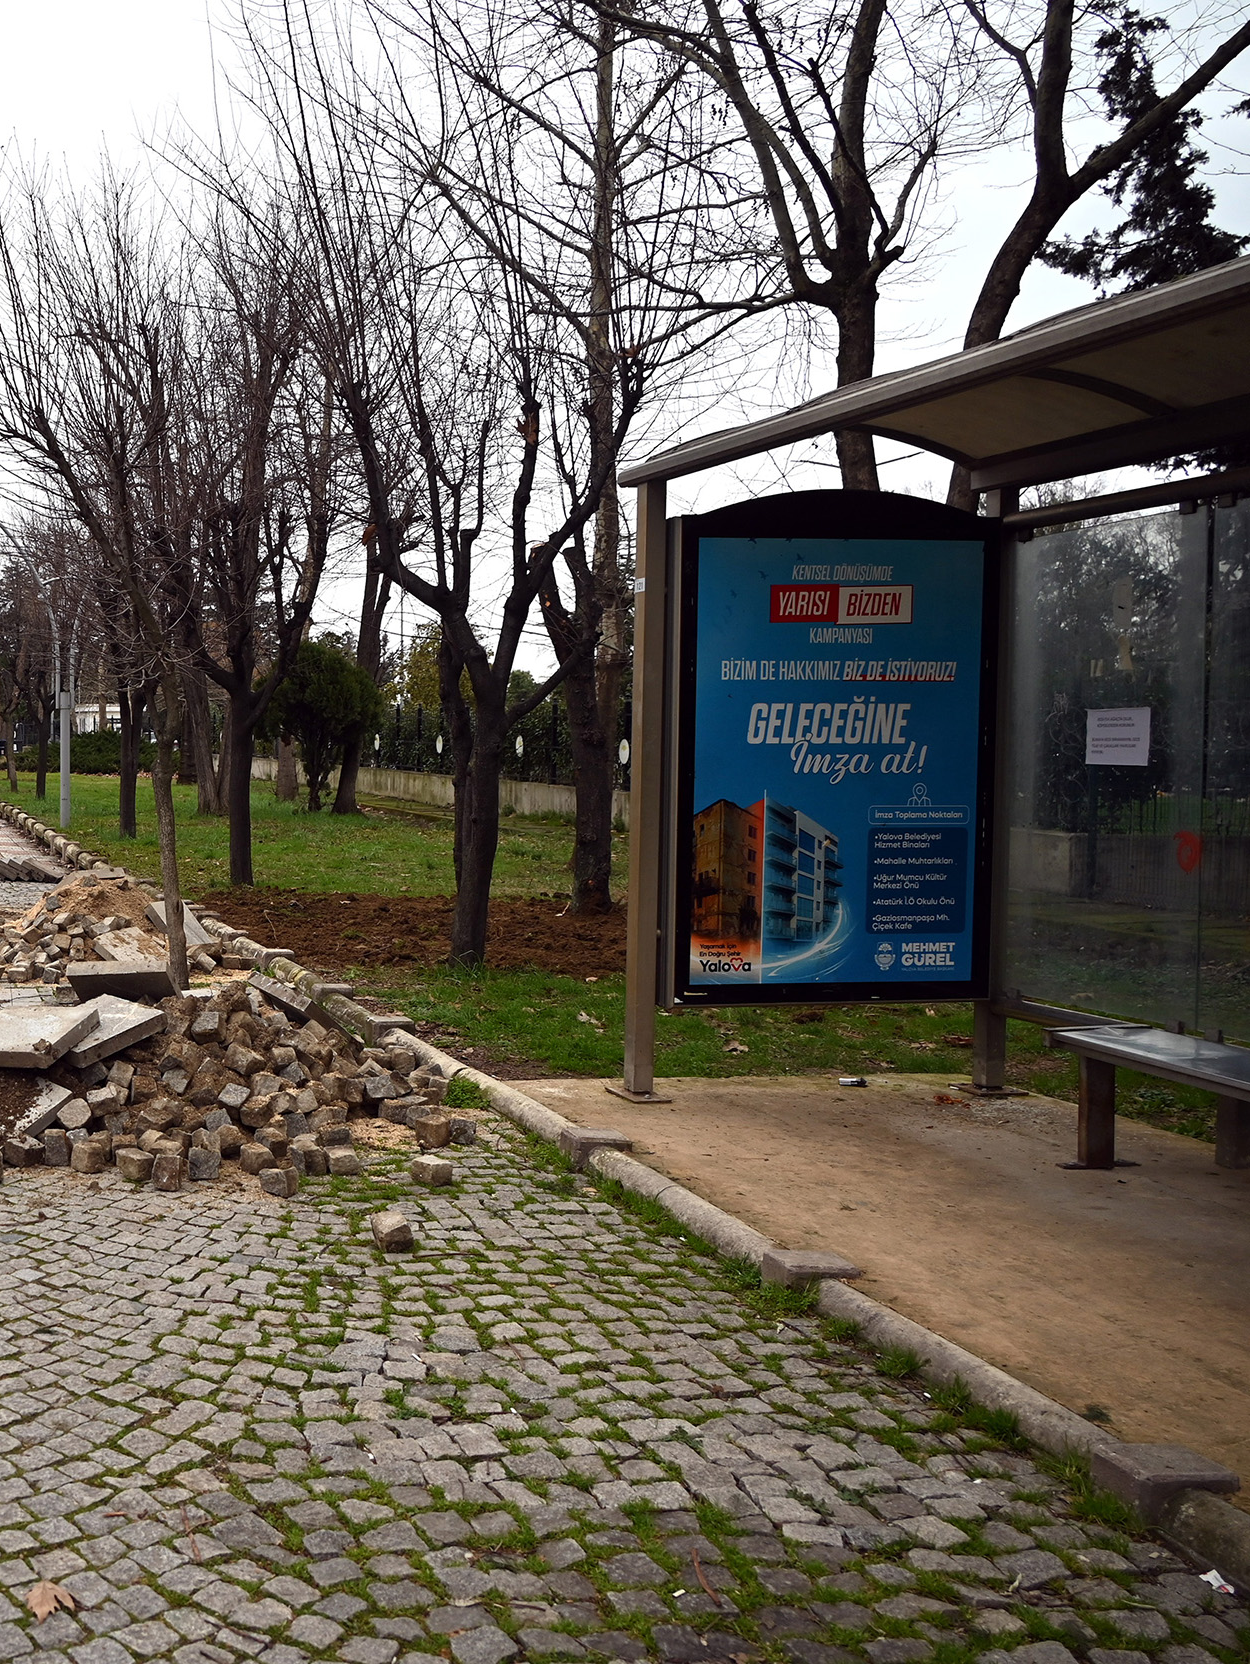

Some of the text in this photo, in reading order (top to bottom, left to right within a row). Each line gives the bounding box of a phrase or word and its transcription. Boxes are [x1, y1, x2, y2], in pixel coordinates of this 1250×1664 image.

[792, 564, 894, 583] KENTSEL DÖNÜŞÜMDE
[778, 588, 902, 617] YARISI BİZDEN
[810, 628, 873, 644] KAMPANYASI
[721, 658, 957, 682] BİZİM DE HAKKIMIZ BİZ DE İSTİYORUZ!
[747, 696, 912, 744] GELECEĞİNE
[790, 732, 928, 784] İmza at!
[875, 810, 894, 818] İmza
[895, 811, 927, 820] Toplama
[904, 833, 942, 842] Belediyesi
[903, 880, 920, 889] Önü
[939, 896, 955, 905] Önü
[872, 922, 894, 931] Çiçek
[901, 942, 956, 952] MEHMET
[699, 958, 751, 972] Yalova
[901, 953, 955, 966] GÜREL
